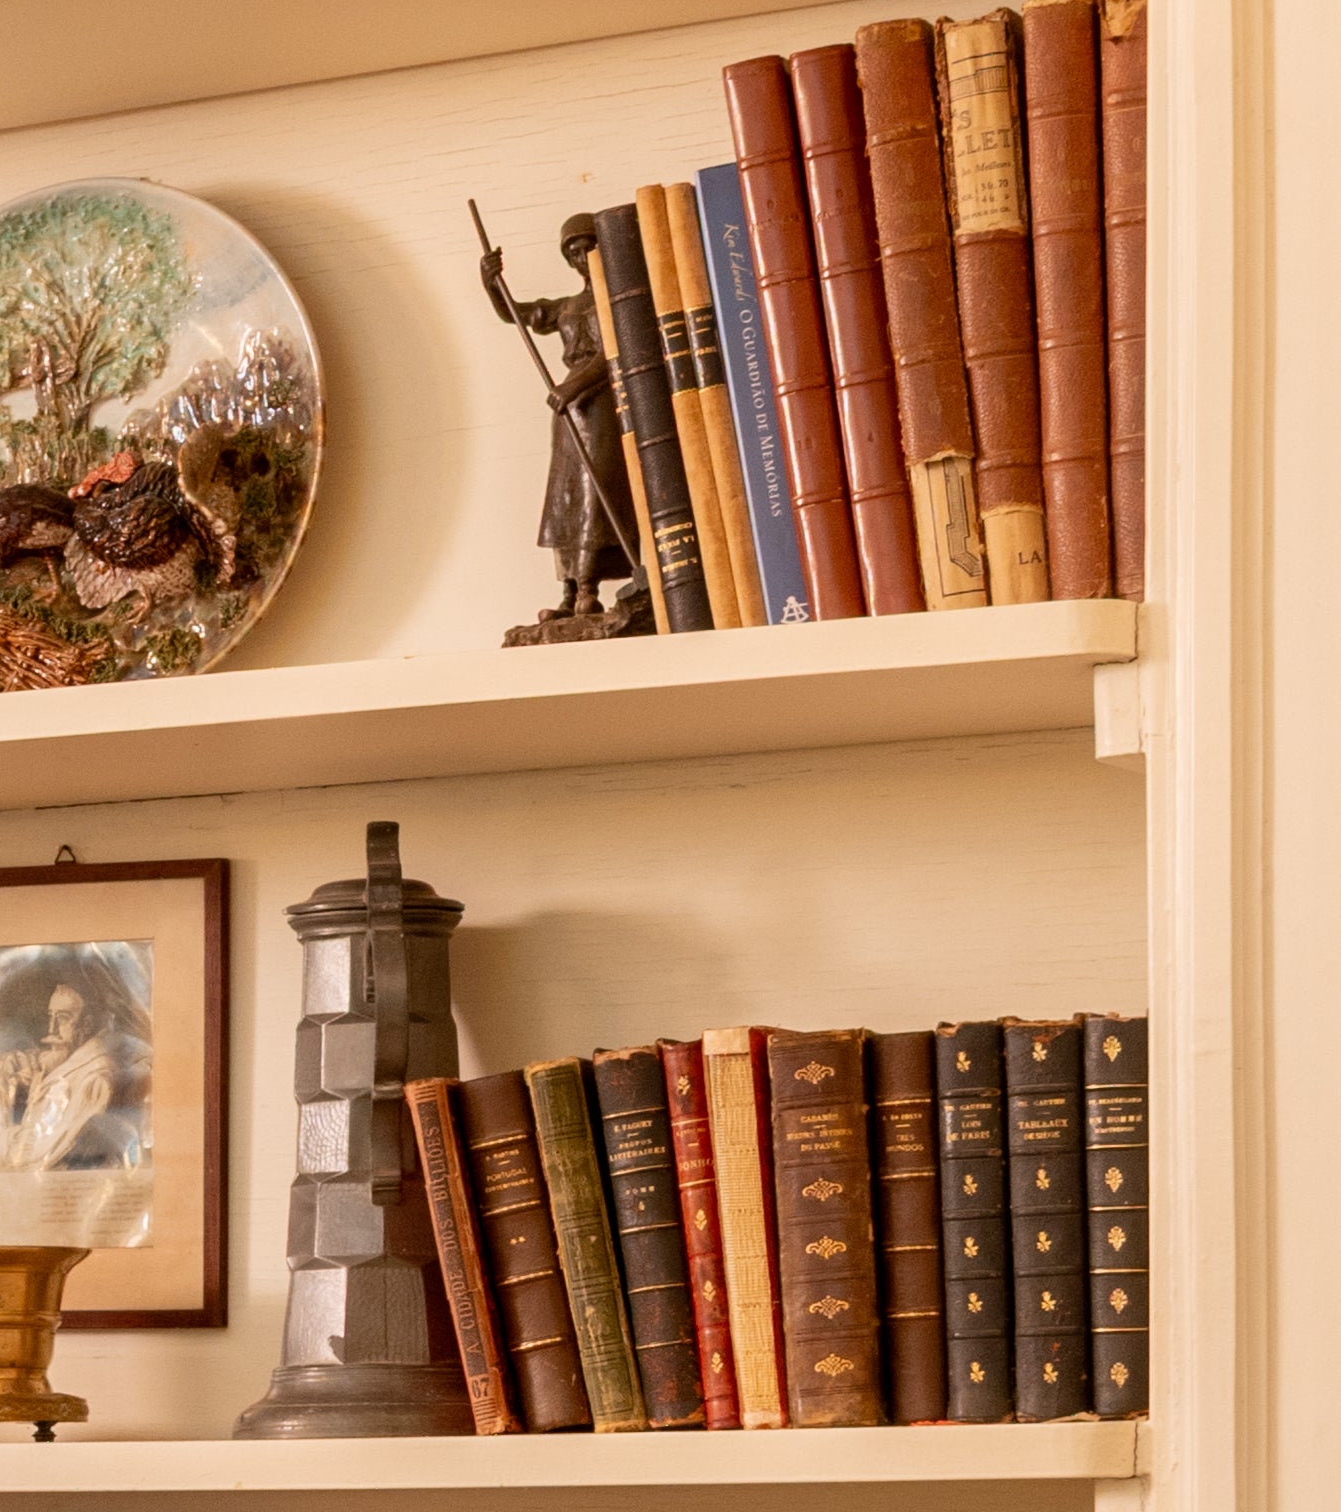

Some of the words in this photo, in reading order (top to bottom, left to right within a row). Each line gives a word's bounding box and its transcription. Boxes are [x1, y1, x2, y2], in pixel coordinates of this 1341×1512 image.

[739, 309, 753, 324] O
[1018, 550, 1042, 565] LA
[1018, 1119, 1069, 1129] TABLEAUX
[486, 1167, 527, 1182] PORTUGAL
[470, 1377, 490, 1399] 67
